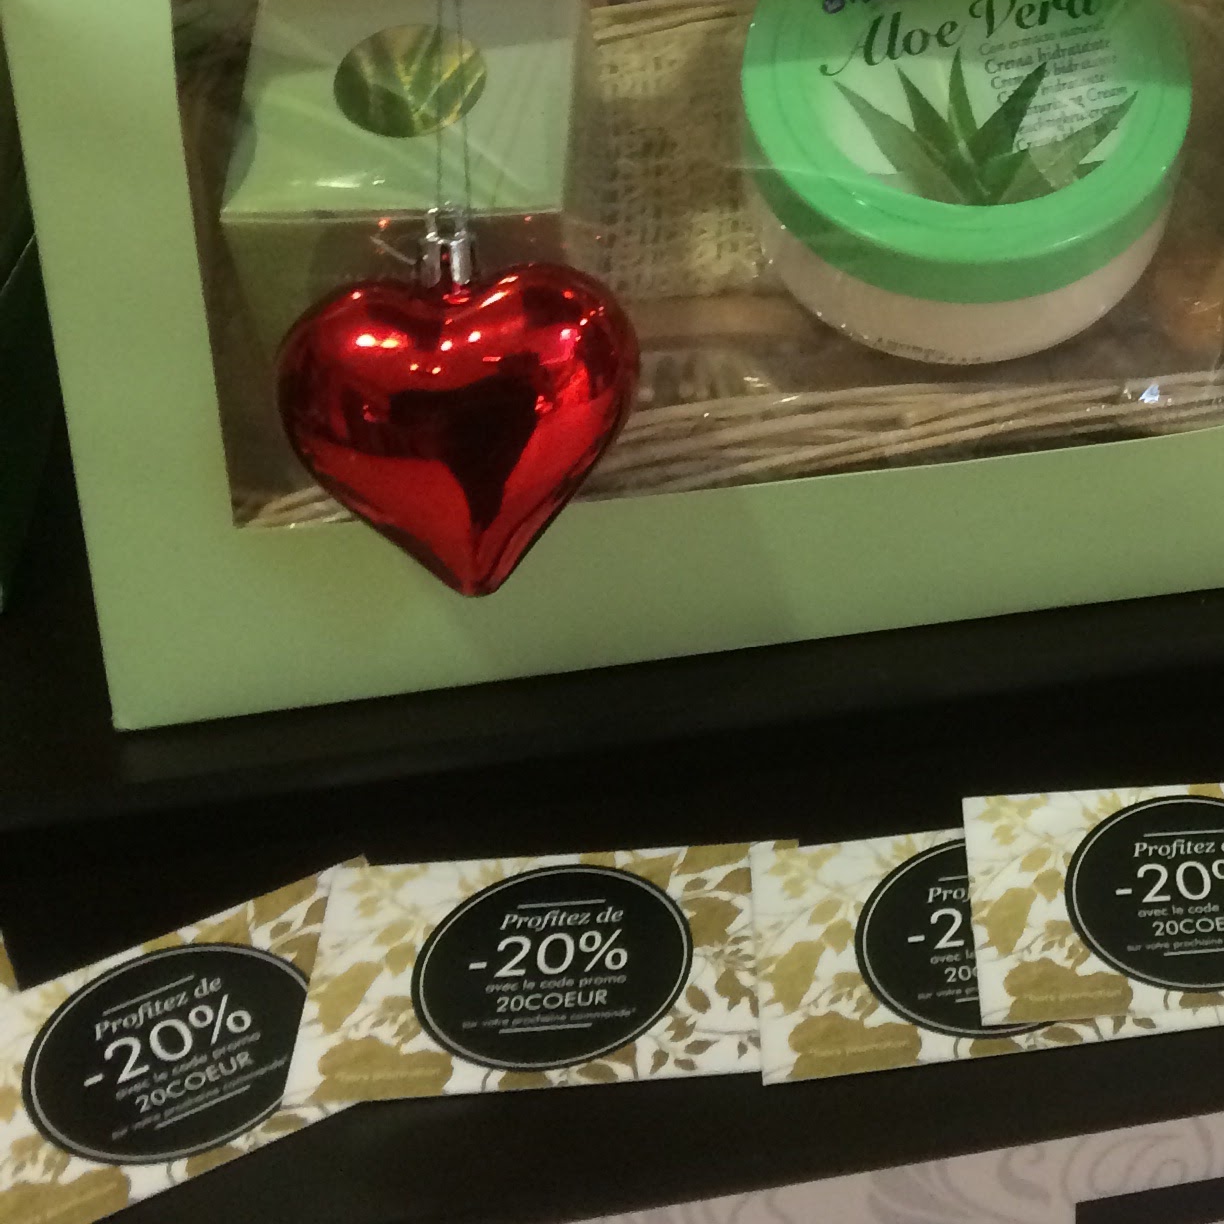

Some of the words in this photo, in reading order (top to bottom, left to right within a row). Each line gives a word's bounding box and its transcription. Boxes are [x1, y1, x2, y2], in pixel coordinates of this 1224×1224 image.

[819, 11, 967, 77] Aloe
[1133, 838, 1216, 860] Profitez
[500, 909, 590, 933] Profitez
[596, 906, 624, 924] de
[908, 907, 965, 949] -2
[1188, 902, 1219, 914] code
[468, 929, 628, 978] -20%
[944, 965, 977, 983] 20
[95, 990, 189, 1040] Profitez
[193, 976, 222, 998] de
[496, 989, 608, 1013] 20COEUR
[84, 994, 251, 1088] -20%
[135, 1051, 255, 1114] 20COEUR
